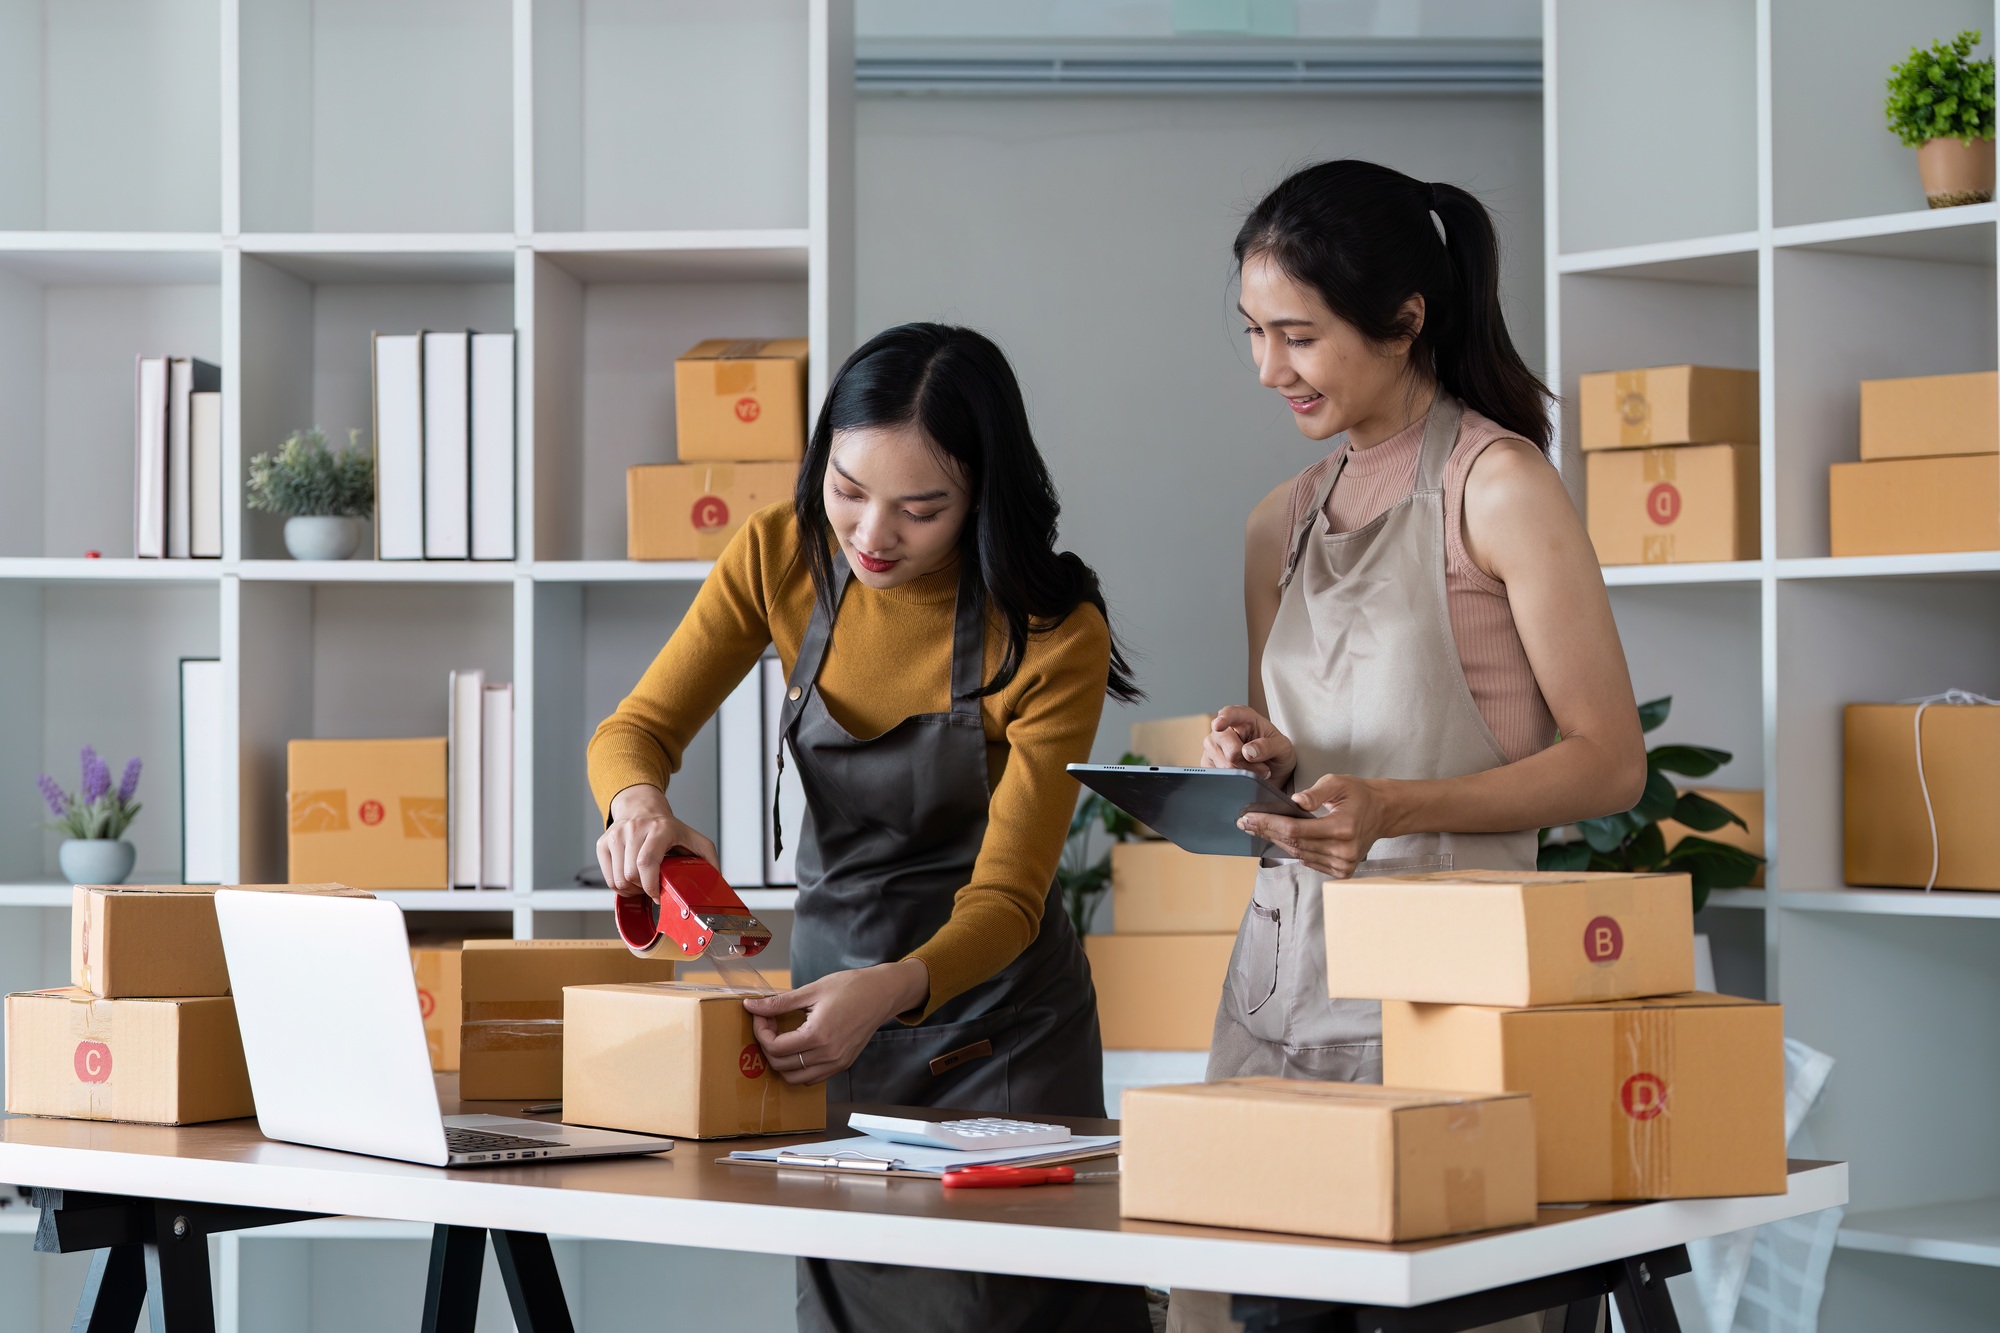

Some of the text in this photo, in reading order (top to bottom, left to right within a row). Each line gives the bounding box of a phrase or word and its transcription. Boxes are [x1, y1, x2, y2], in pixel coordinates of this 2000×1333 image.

[702, 504, 718, 526] C
[1655, 491, 1671, 518] D
[1595, 928, 1613, 956] B
[85, 1049, 101, 1076] C
[742, 1053, 764, 1070] 2A
[1632, 1081, 1659, 1111] D
